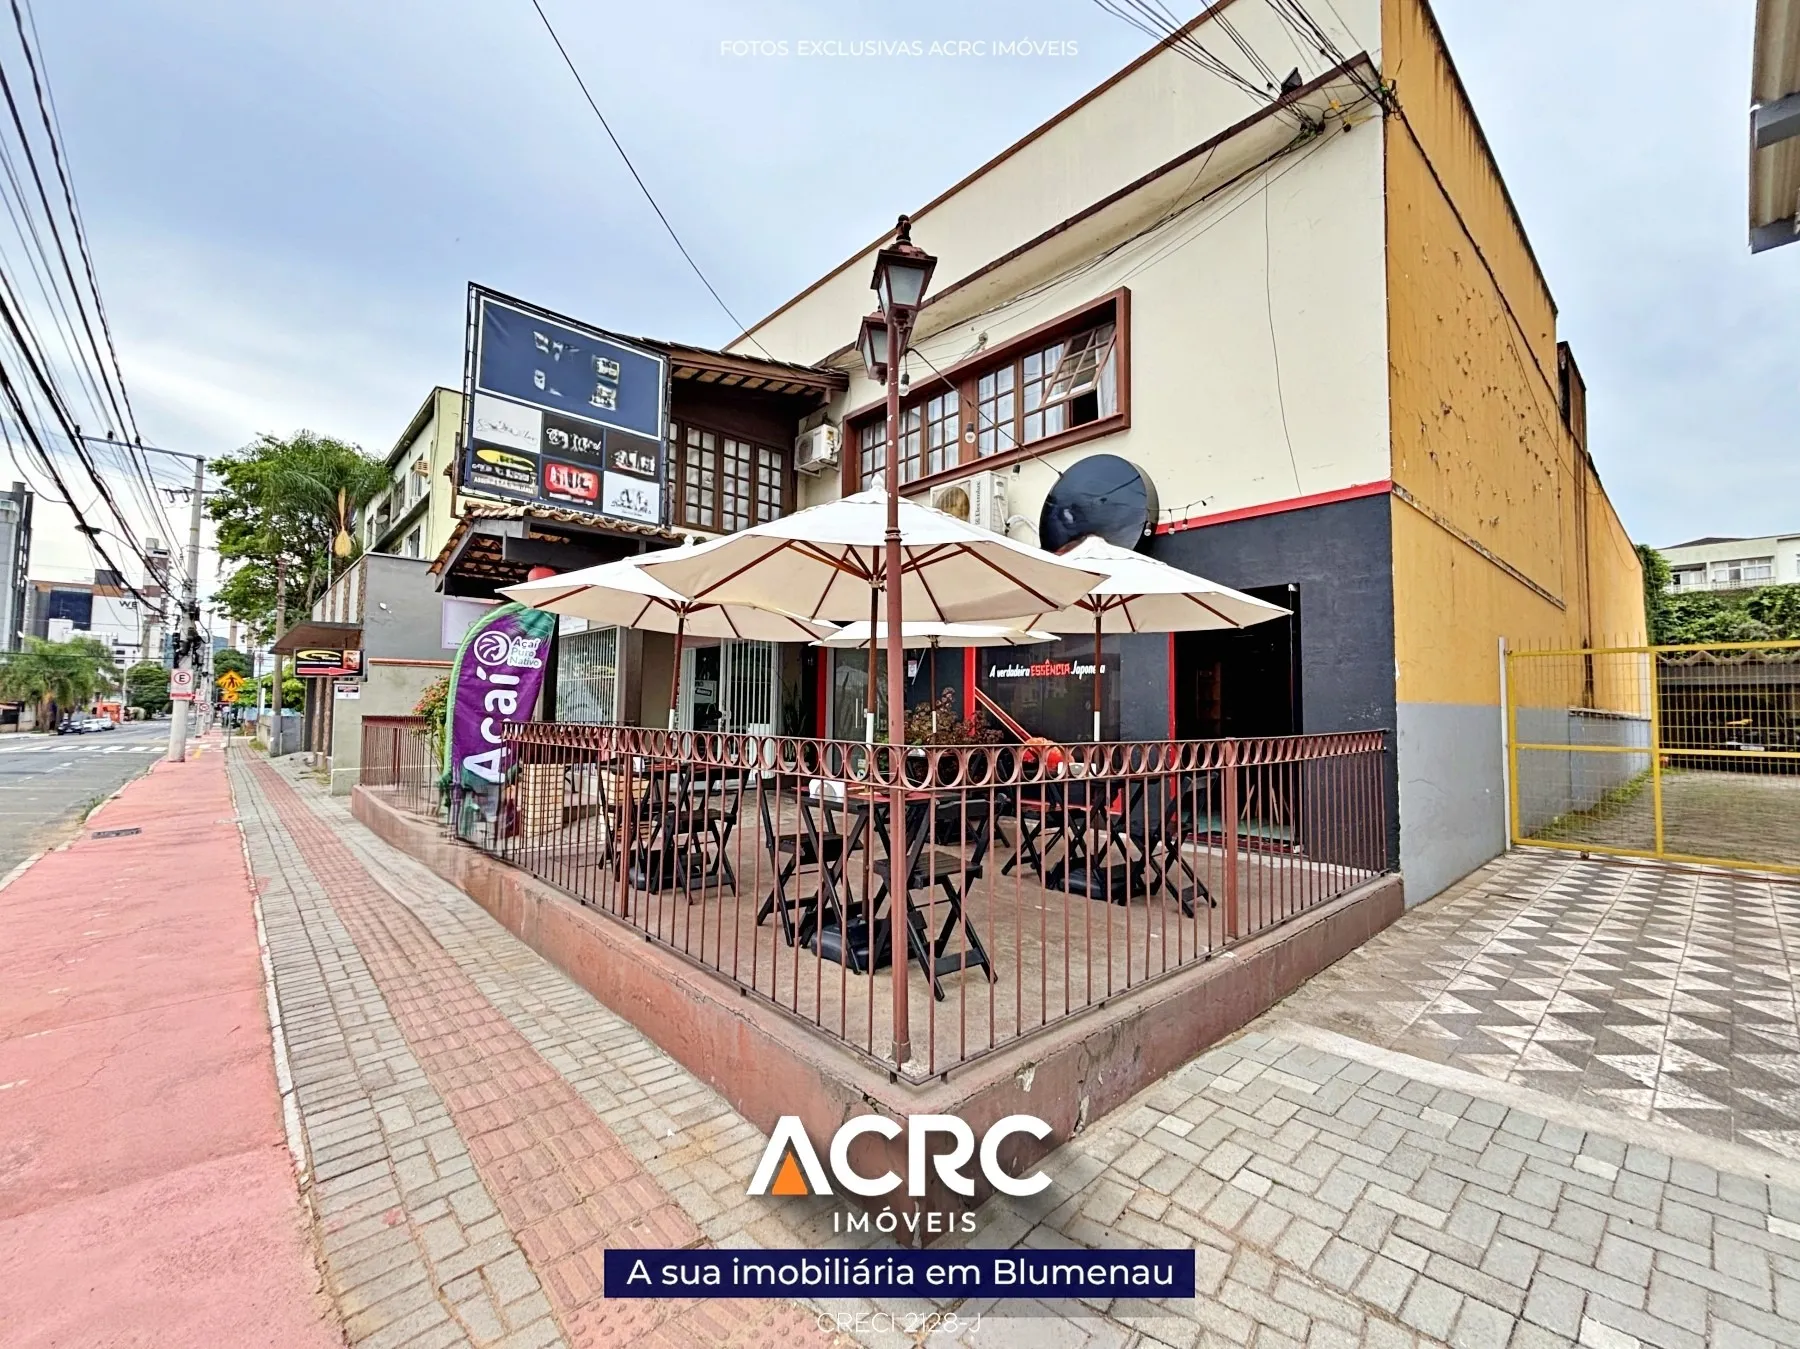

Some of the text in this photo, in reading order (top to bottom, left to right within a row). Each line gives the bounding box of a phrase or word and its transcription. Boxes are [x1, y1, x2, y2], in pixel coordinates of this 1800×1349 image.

[513, 636, 540, 649] Açaí
[511, 646, 534, 657] Puro
[510, 656, 540, 666] Nativo
[989, 659, 1106, 680] A verdadeira ESSÊNCIA Japonea
[179, 674, 186, 682] E
[463, 666, 520, 783] Açaí
